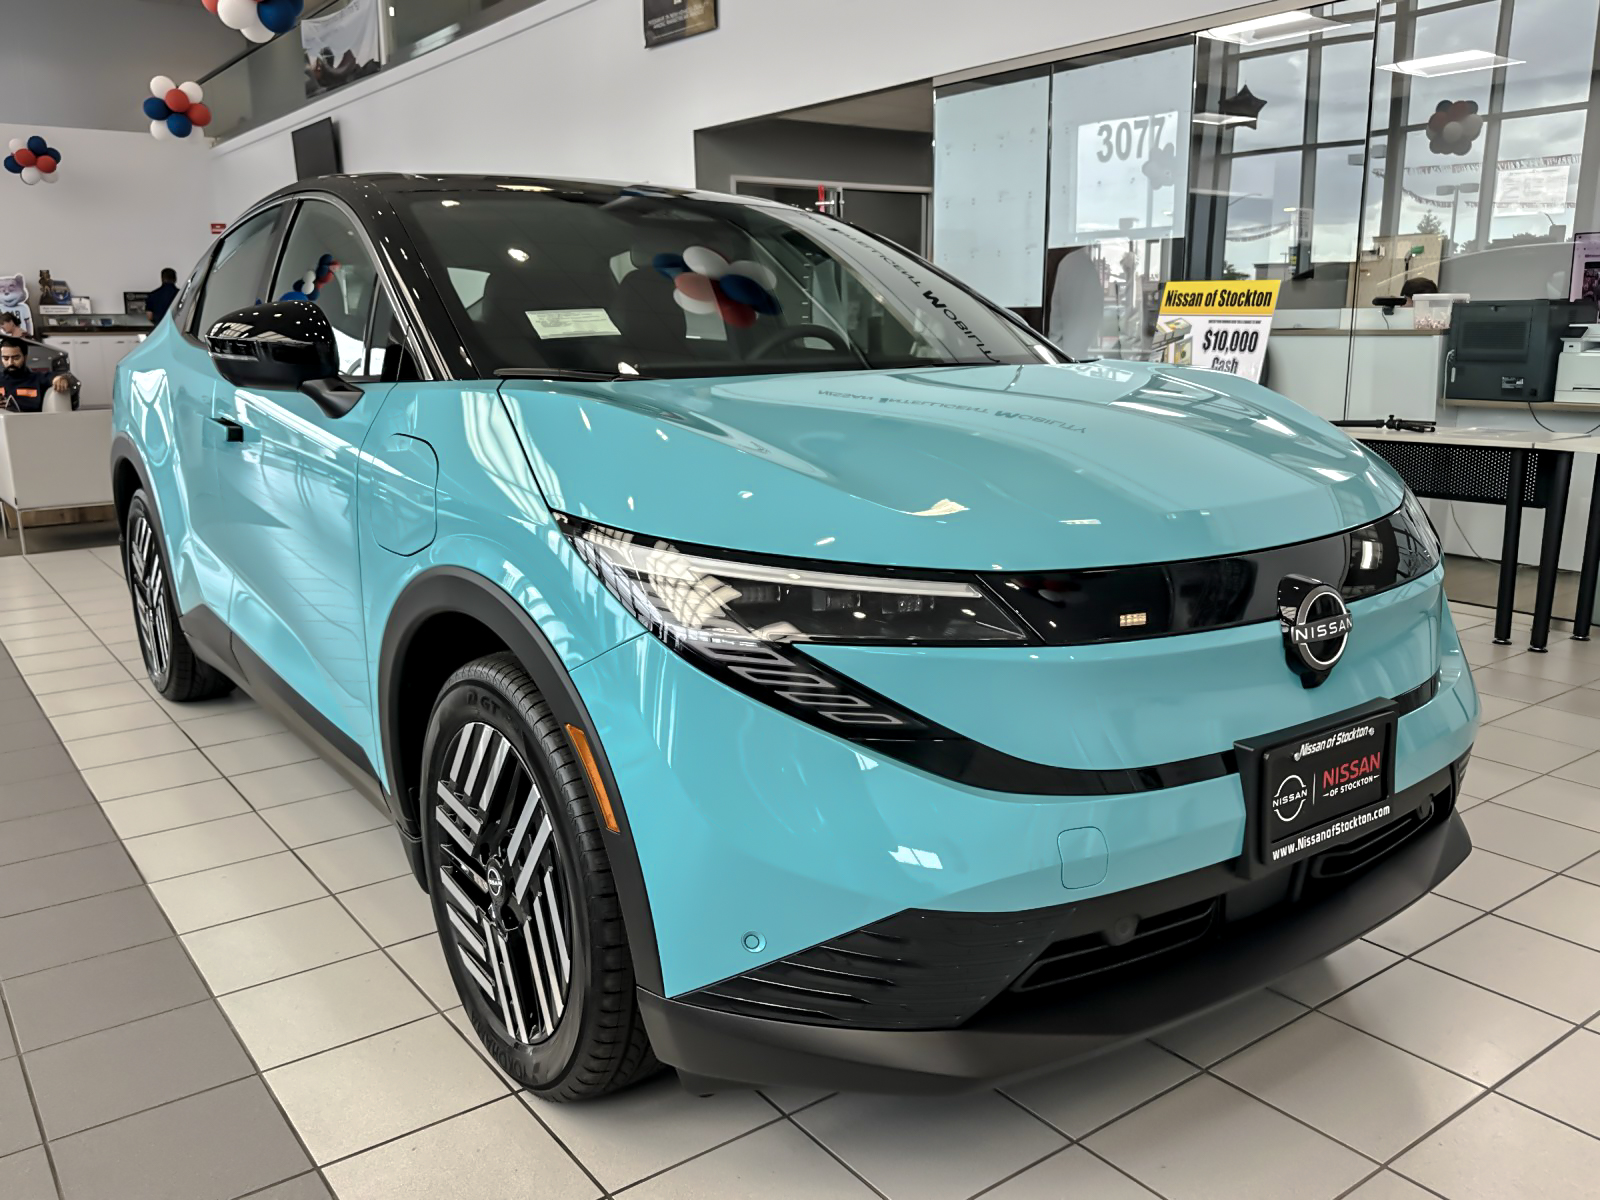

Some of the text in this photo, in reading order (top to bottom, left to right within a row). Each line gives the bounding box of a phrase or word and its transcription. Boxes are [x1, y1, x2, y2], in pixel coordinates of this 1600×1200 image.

[1096, 116, 1166, 163] 3077
[1164, 288, 1273, 307] Nissan of Stockton
[1202, 329, 1259, 354] $10,000
[1211, 356, 1239, 374] Cash
[1295, 617, 1353, 641] NISSAN
[1300, 726, 1369, 757] Nissan of Stockton
[1323, 752, 1381, 789] NISSAN
[1272, 788, 1308, 808] NISSAN
[1329, 775, 1373, 797] OF STOCKTON
[1272, 805, 1391, 861] www.NissanofStockton.com
